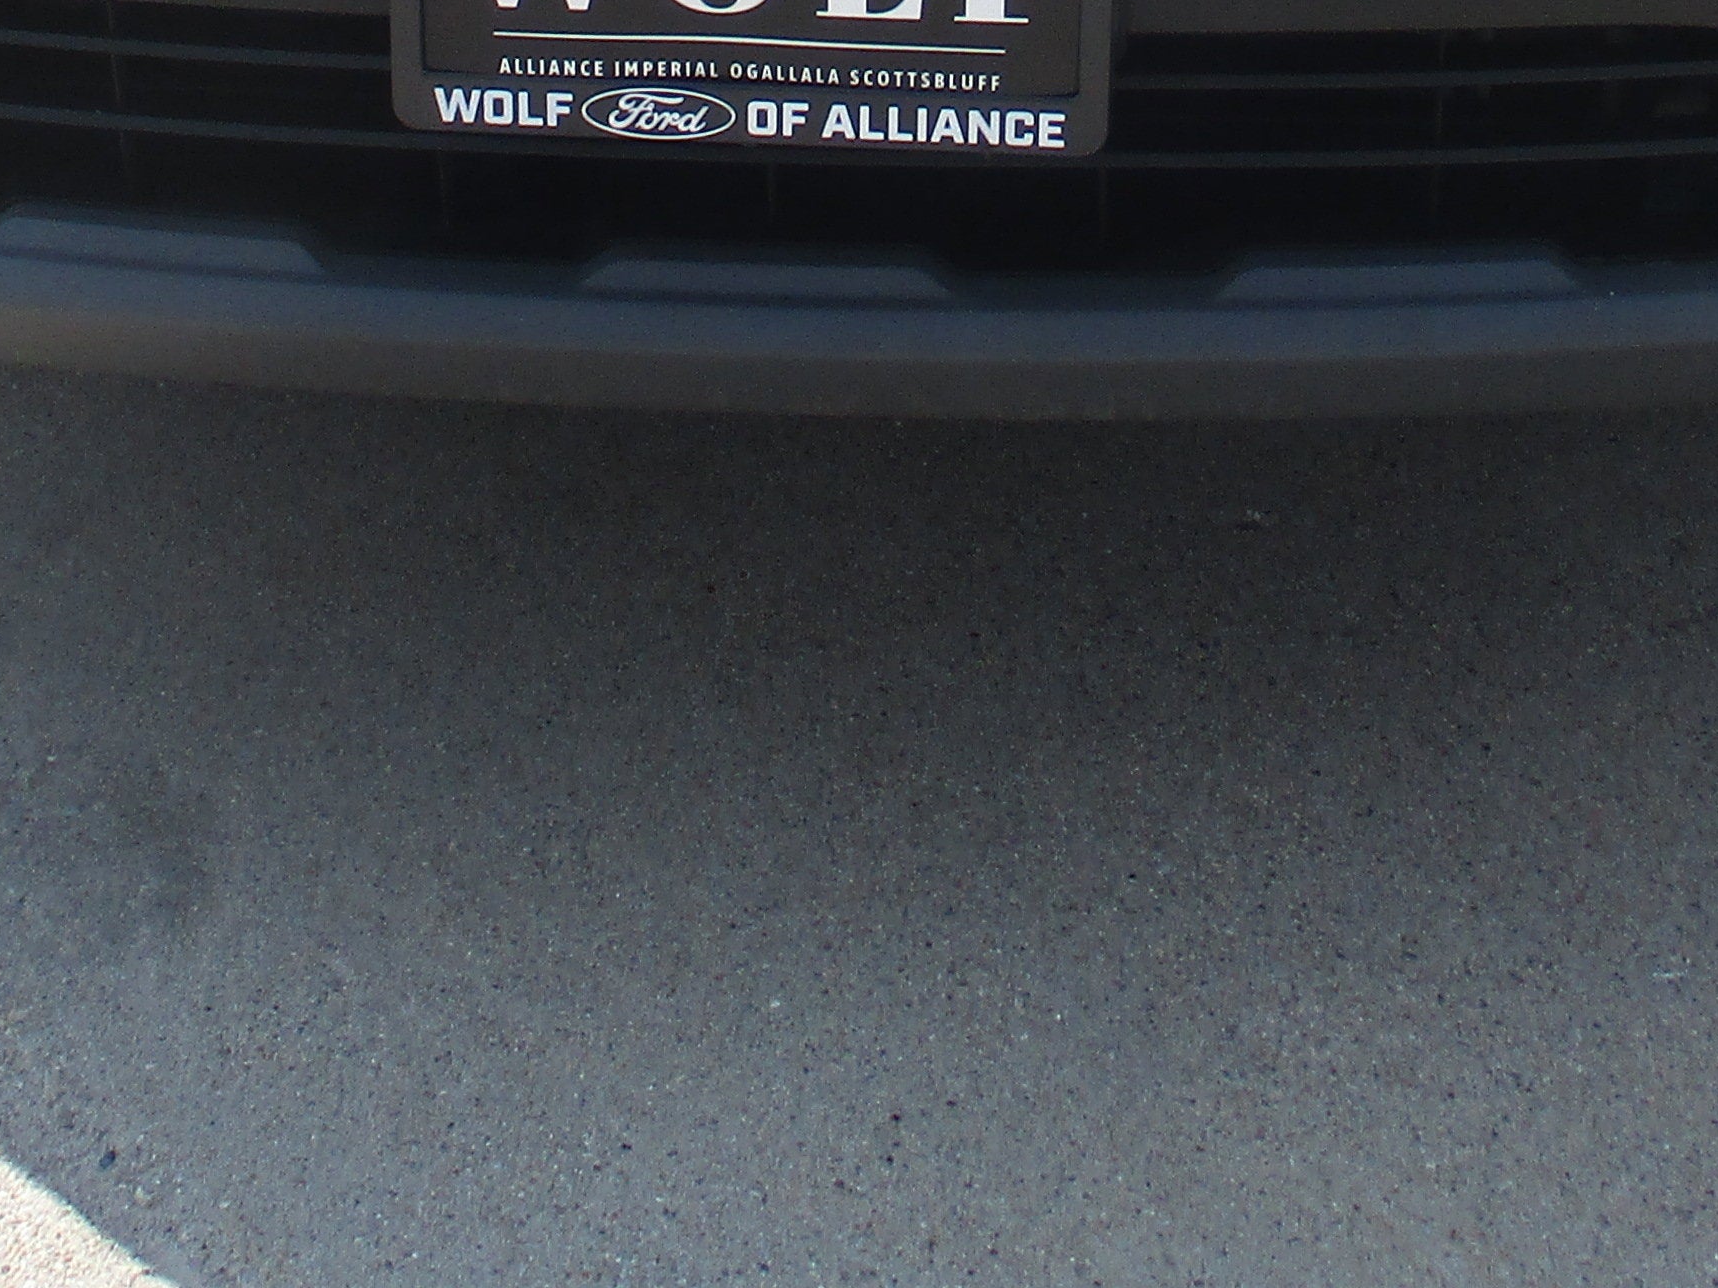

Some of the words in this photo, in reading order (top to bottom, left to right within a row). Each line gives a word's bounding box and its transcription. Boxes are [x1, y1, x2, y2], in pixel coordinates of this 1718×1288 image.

[499, 57, 604, 78] ALLIANCE
[613, 59, 719, 80] IMPERIAL
[729, 62, 840, 86] OGALLALA
[849, 68, 1002, 93] SCOTTSBLUFF
[433, 86, 574, 127] WOLF
[608, 93, 710, 132] Ford
[747, 100, 810, 137] OF
[821, 104, 1067, 149] ALLIANCE
